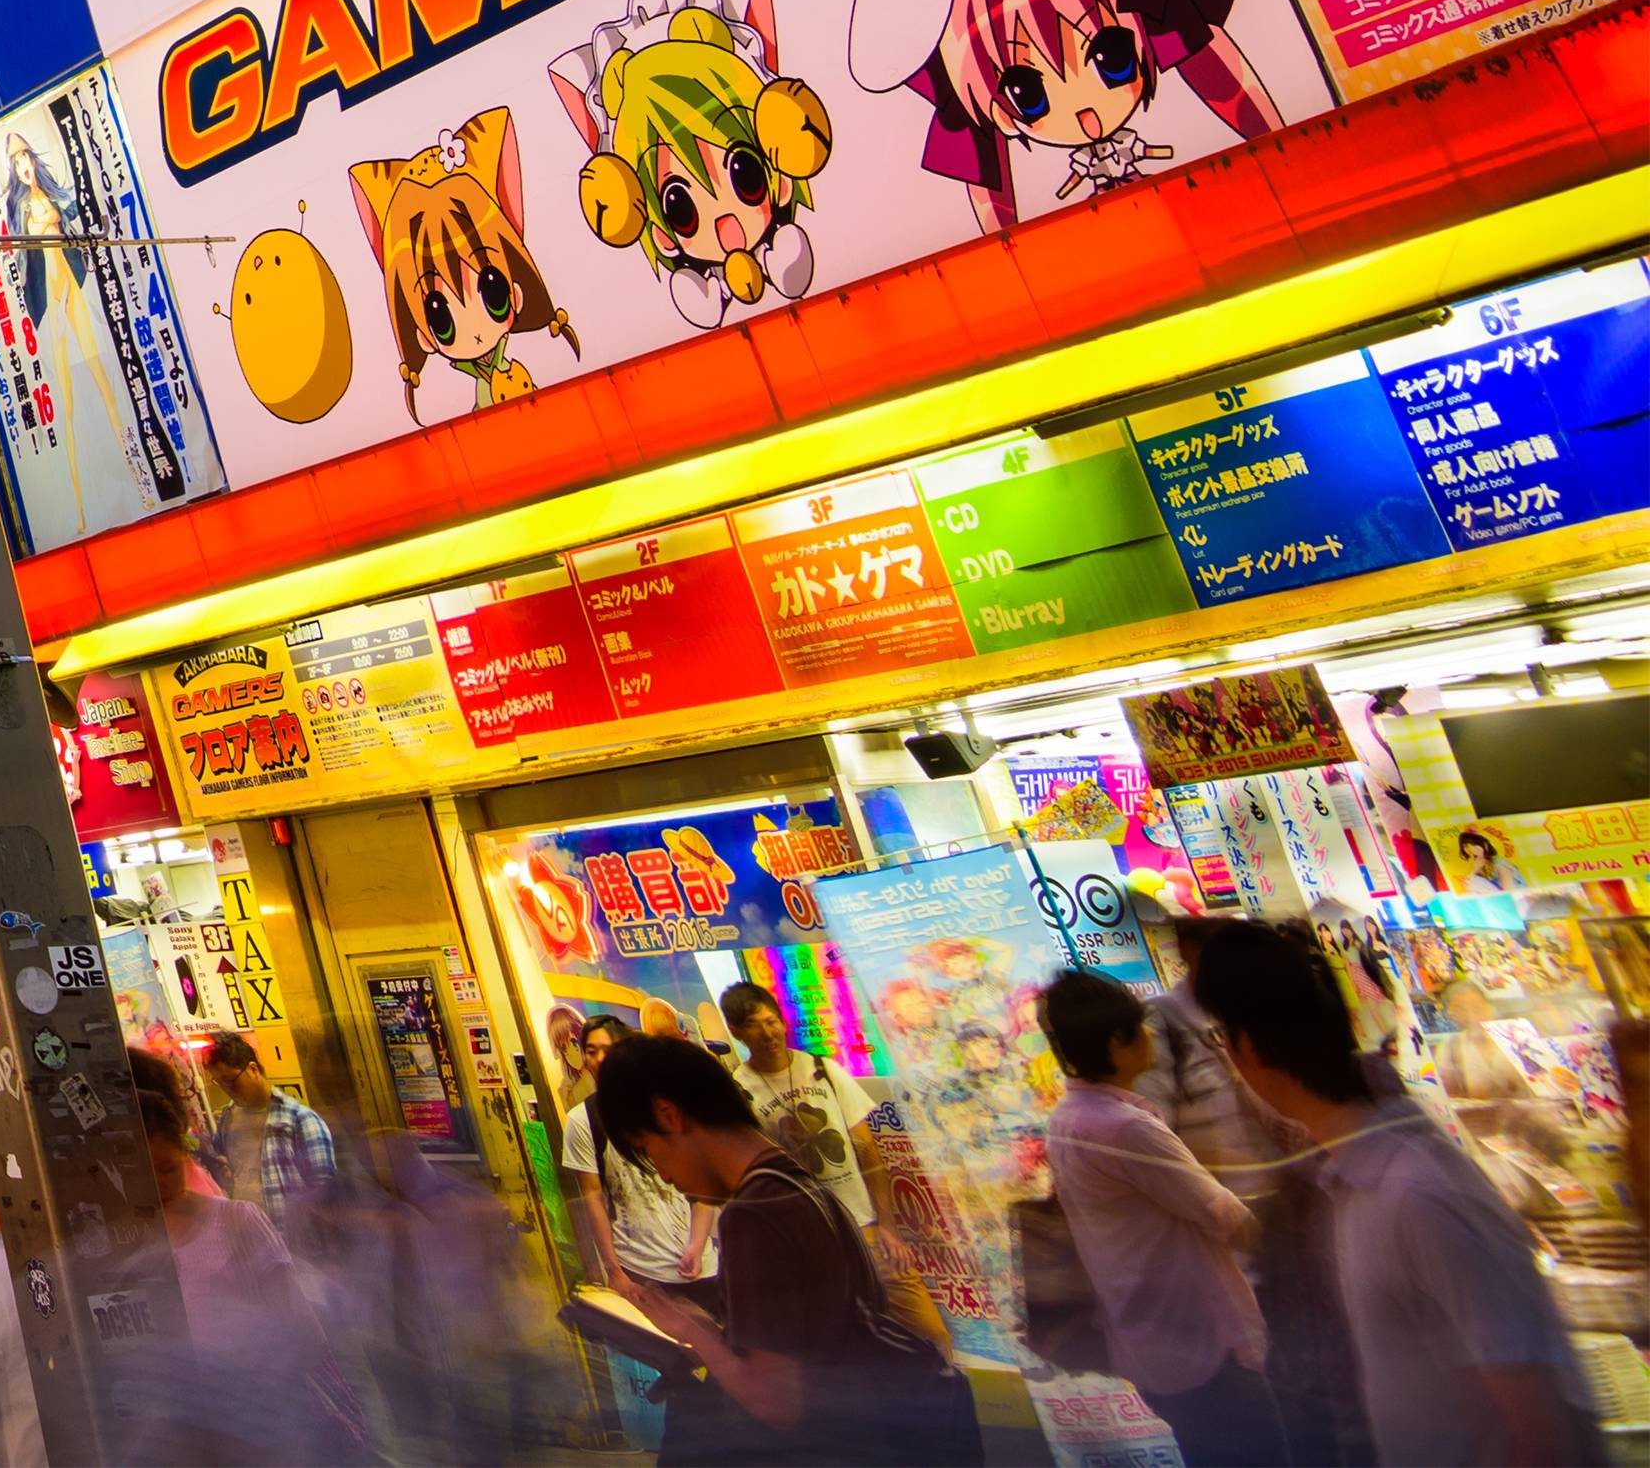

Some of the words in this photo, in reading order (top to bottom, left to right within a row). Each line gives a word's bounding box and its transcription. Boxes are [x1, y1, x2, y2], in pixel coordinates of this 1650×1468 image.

[1476, 295, 1528, 339] 6F
[1211, 387, 1251, 421] 5F
[809, 495, 834, 524] 3F
[943, 503, 979, 534] CD
[635, 540, 660, 565] 2F
[962, 548, 1015, 585] DVD
[982, 598, 1065, 635] Blu-ray
[170, 672, 285, 717] GAMERS
[180, 713, 310, 778] フロア案内
